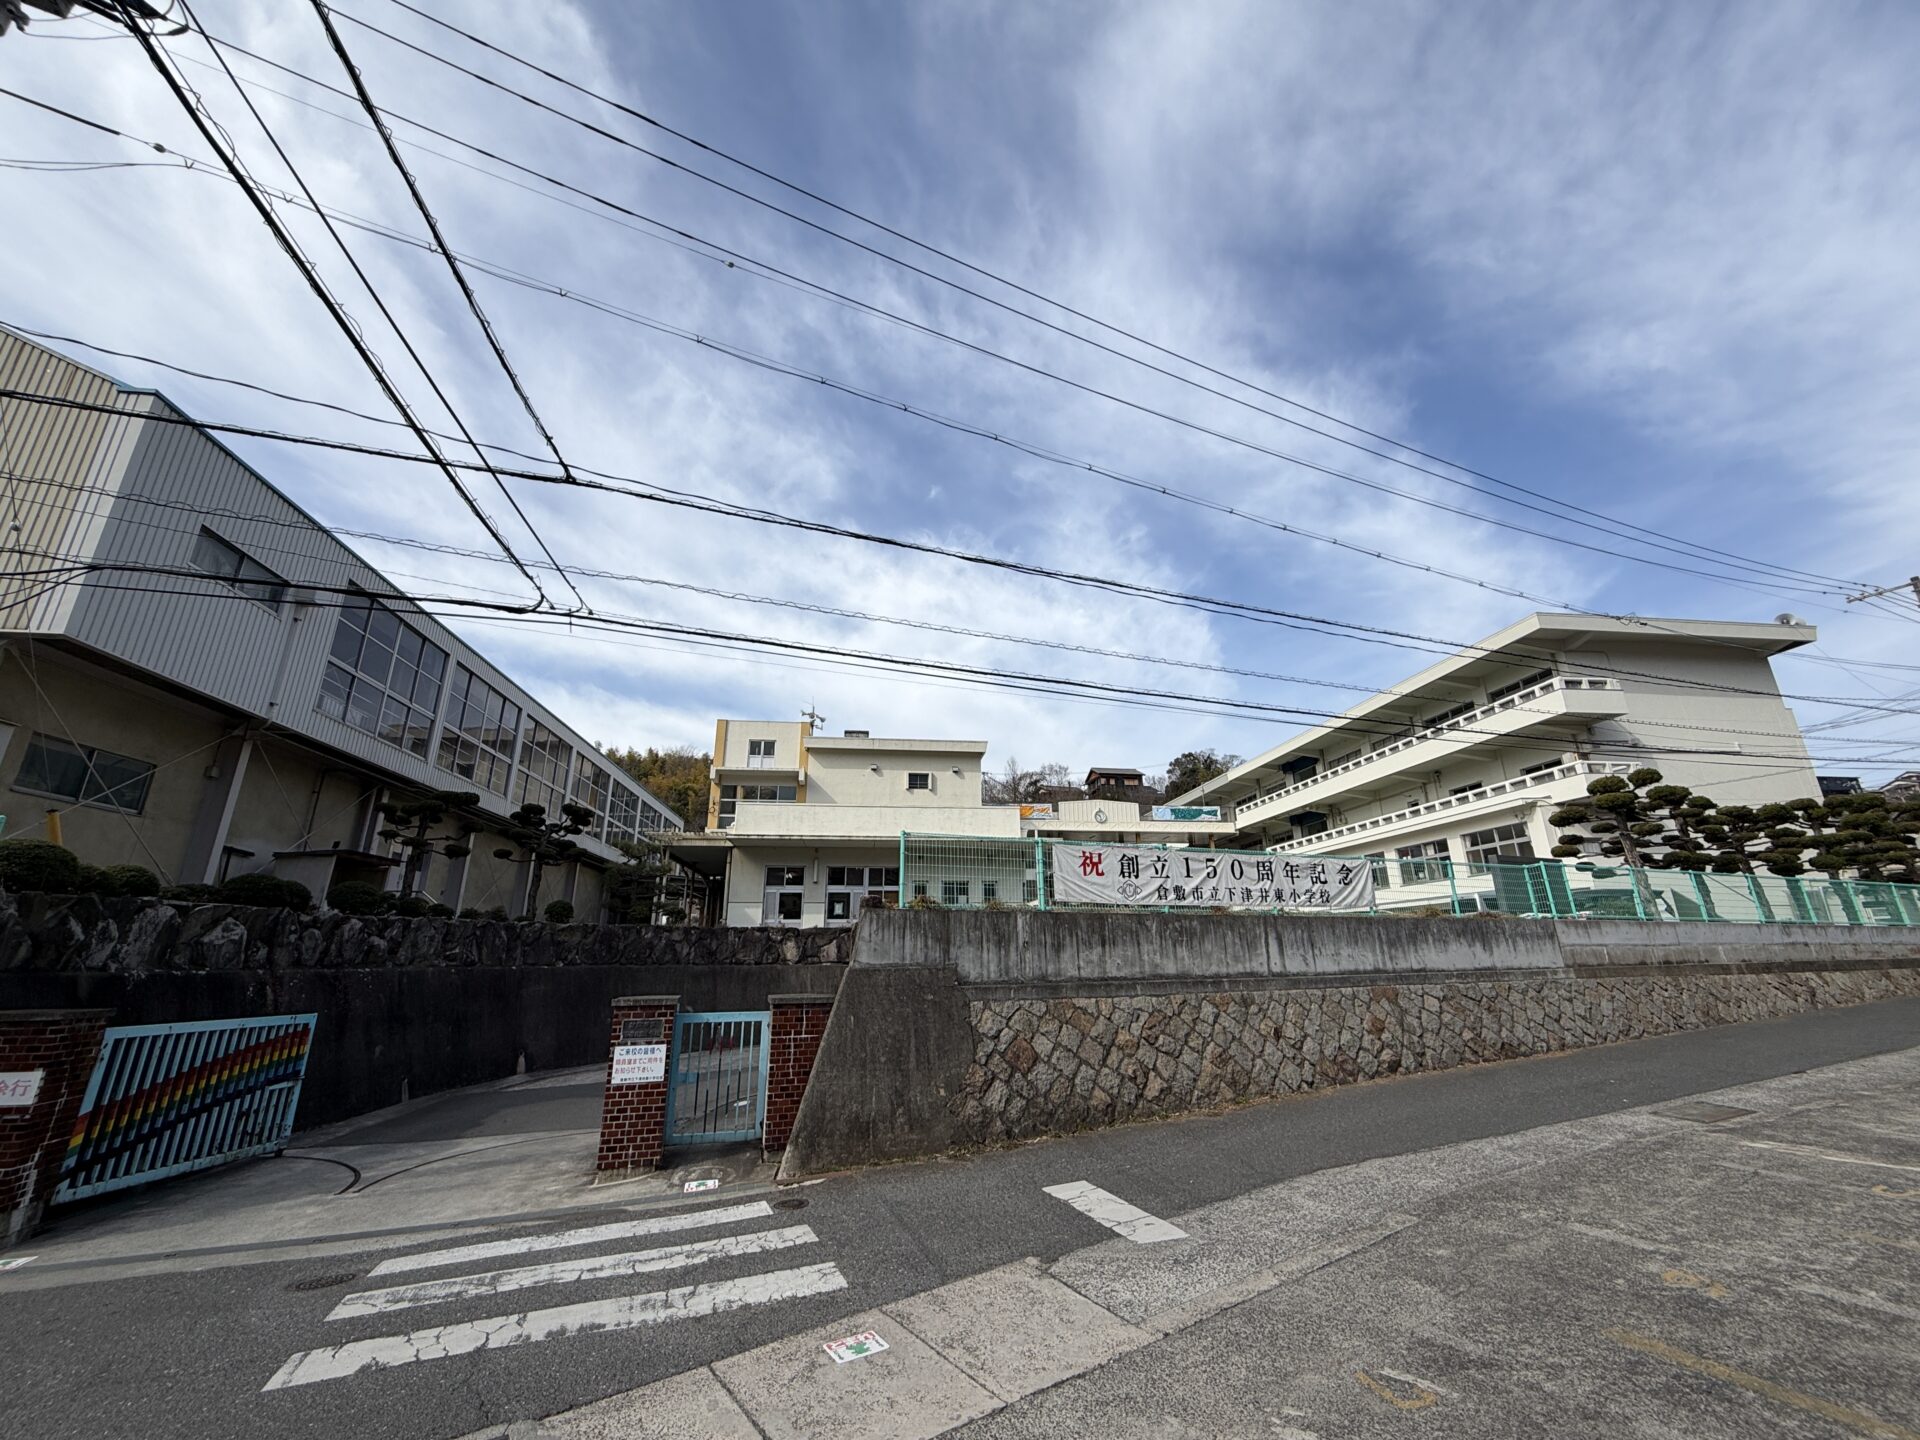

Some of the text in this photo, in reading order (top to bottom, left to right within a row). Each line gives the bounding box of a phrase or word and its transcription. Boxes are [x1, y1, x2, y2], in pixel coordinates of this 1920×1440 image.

[1078, 850, 1353, 886] 祝 創立150周年記念
[1156, 884, 1331, 904] 倉敷市立下津井東小学校
